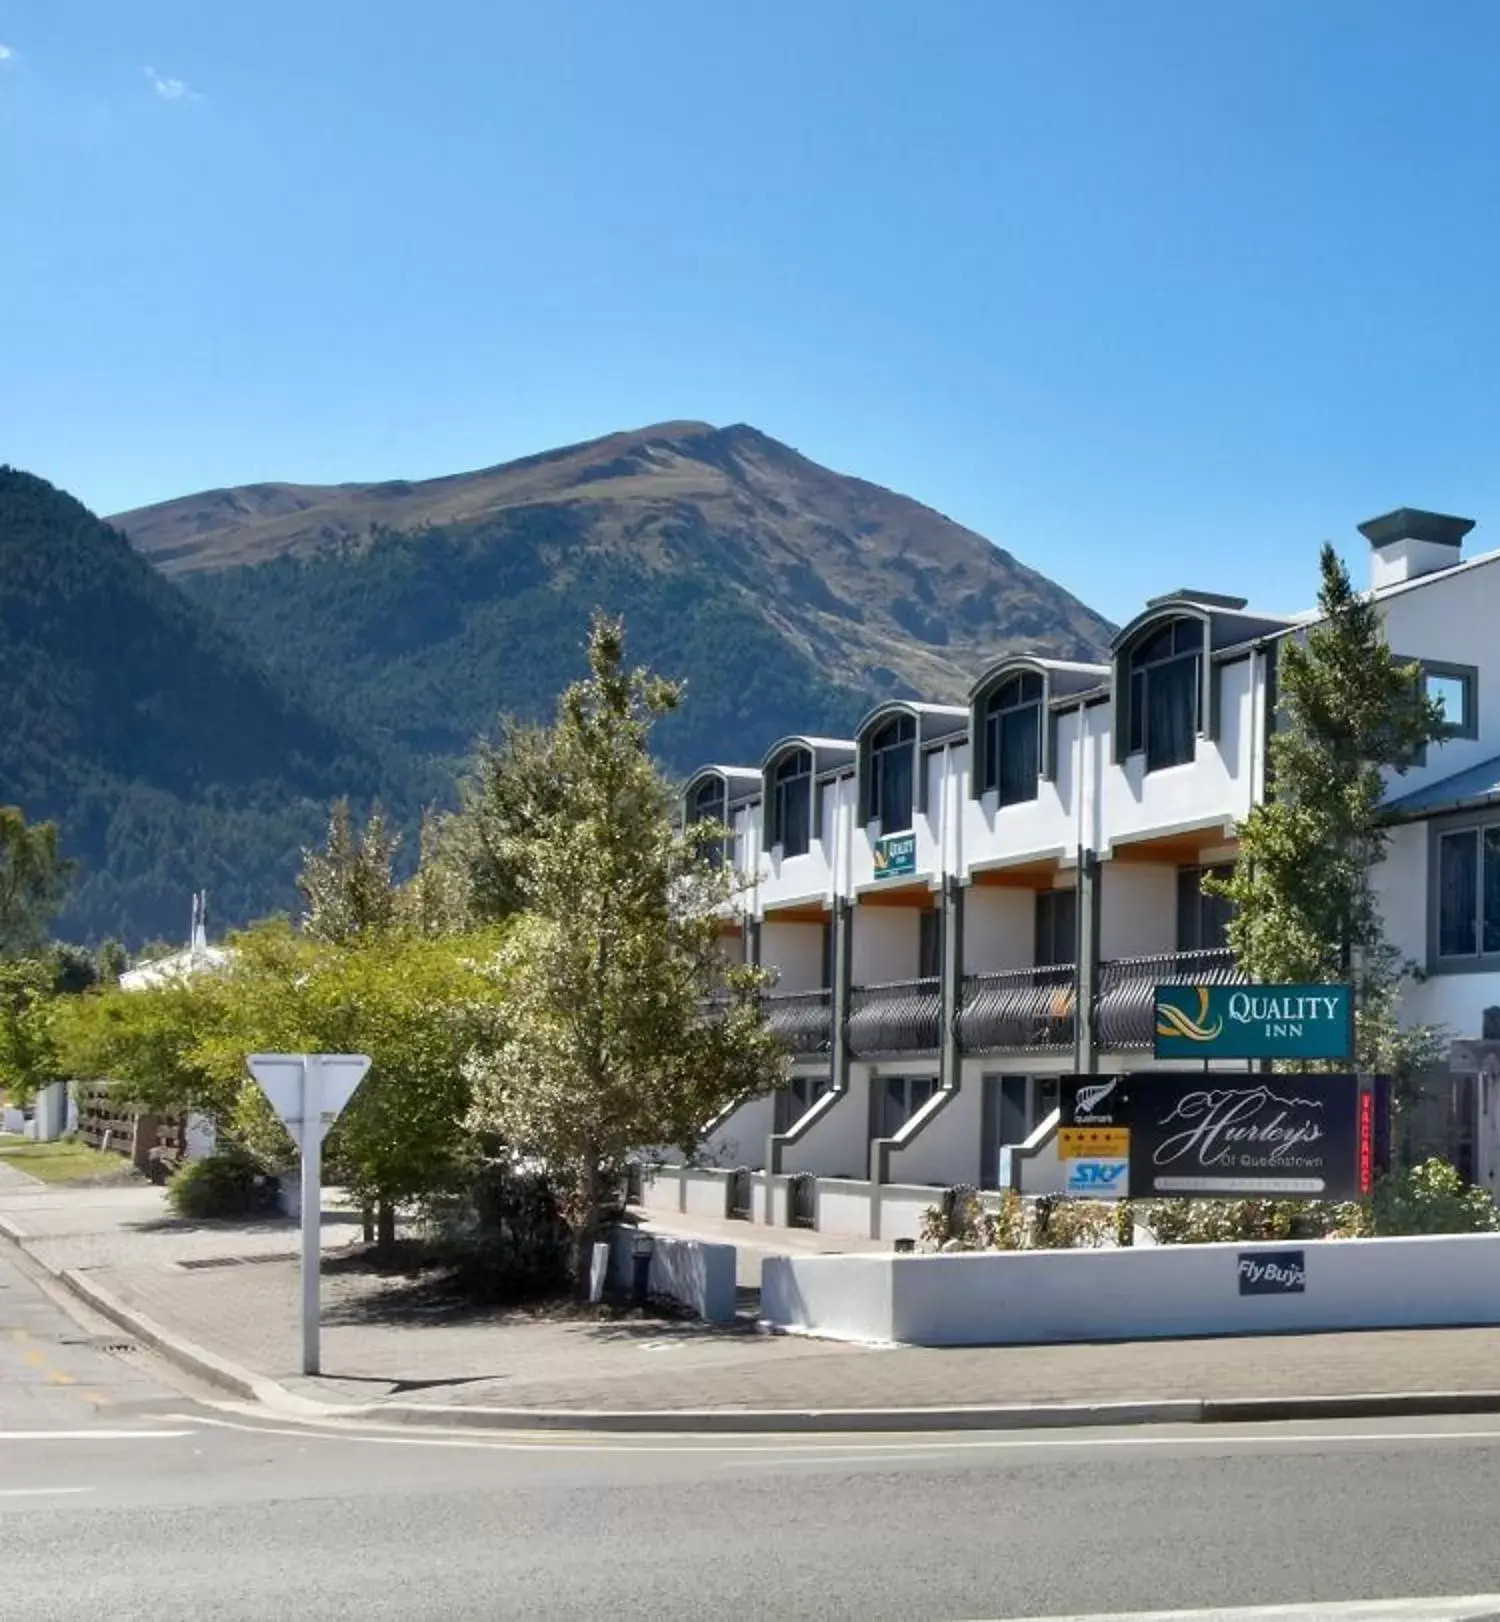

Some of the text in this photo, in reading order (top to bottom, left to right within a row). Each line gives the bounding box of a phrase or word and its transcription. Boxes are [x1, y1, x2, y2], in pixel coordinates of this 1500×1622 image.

[1229, 991, 1339, 1024] QUALITY
[1265, 1023, 1303, 1037] INN
[1153, 1091, 1323, 1167] Hurley's
[1240, 1154, 1323, 1167] Queenstown
[1069, 1164, 1127, 1183] SKY
